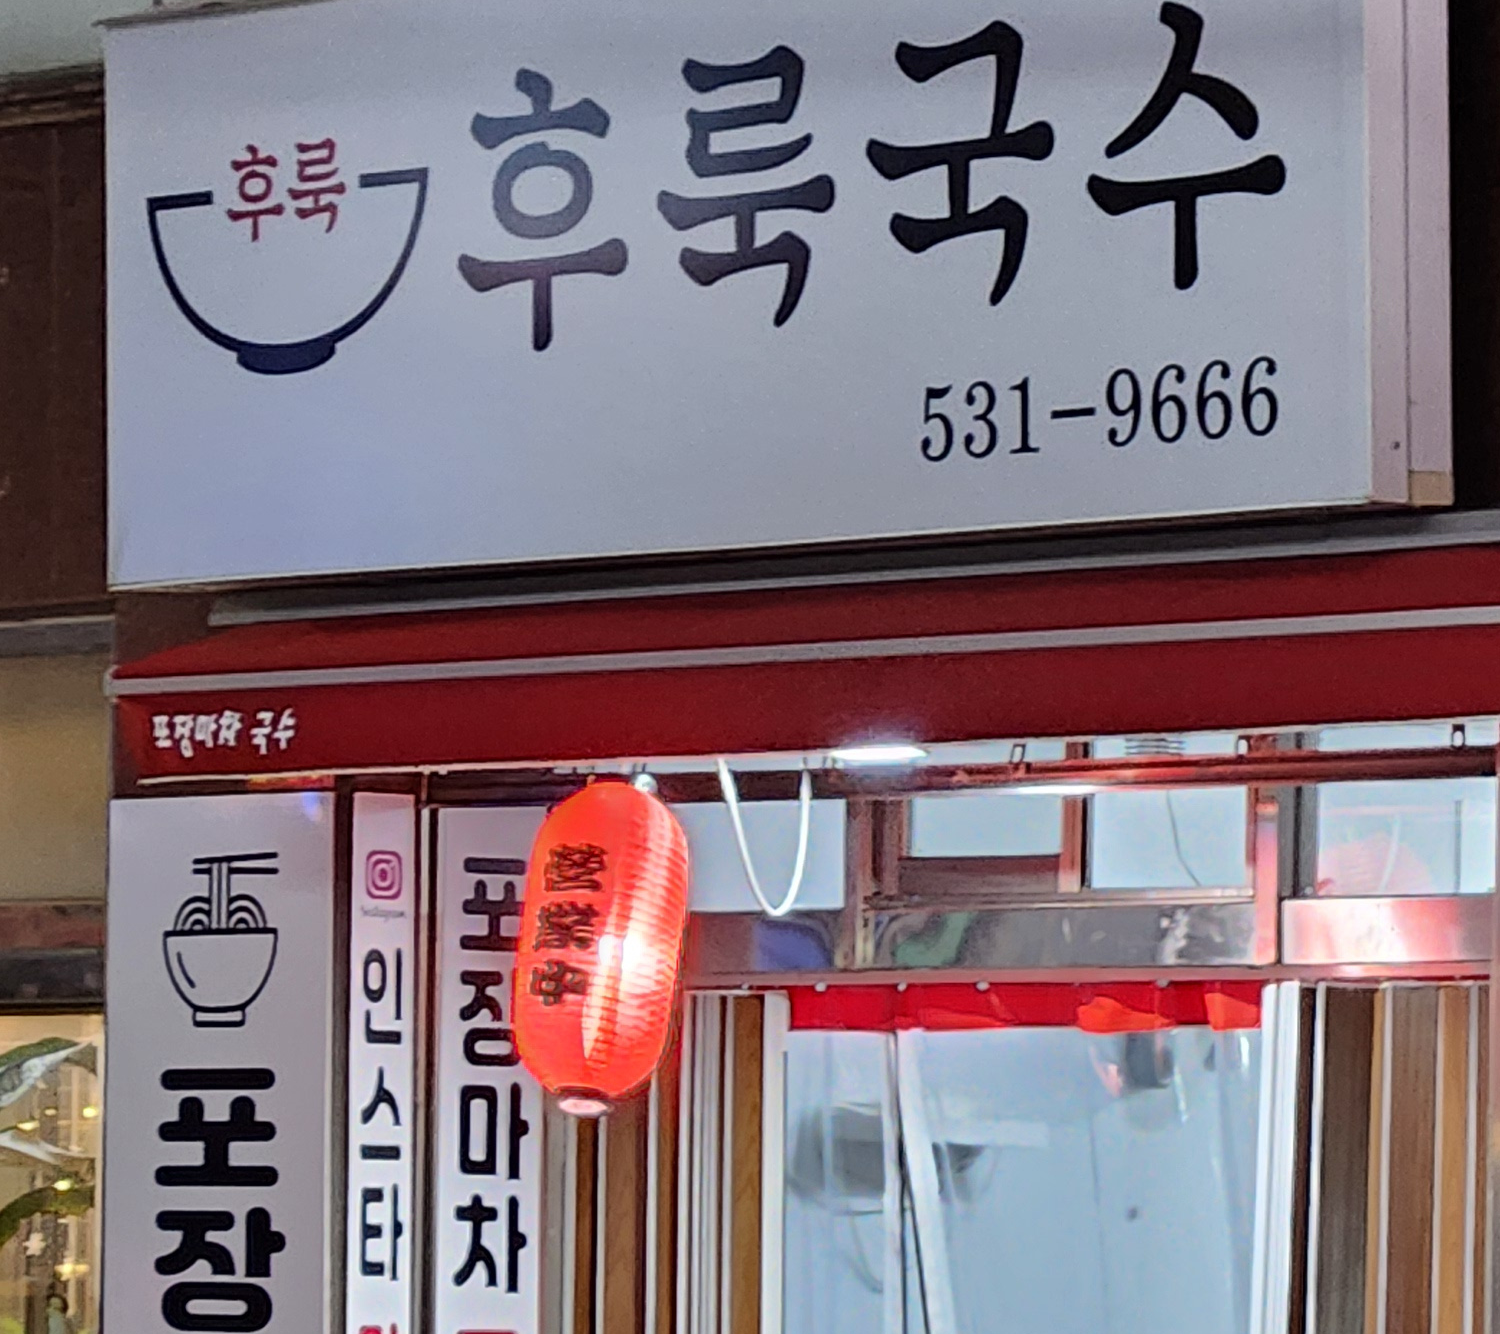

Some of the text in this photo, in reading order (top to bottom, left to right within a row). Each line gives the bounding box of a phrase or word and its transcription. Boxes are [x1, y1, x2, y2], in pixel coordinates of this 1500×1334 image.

[226, 137, 346, 242] 후룩
[458, 1, 1286, 352] 후룩국수
[920, 356, 1279, 462] 531-9666
[250, 708, 296, 755] 국수
[360, 948, 404, 1281] 인스타
[452, 856, 529, 1293] 포장마차
